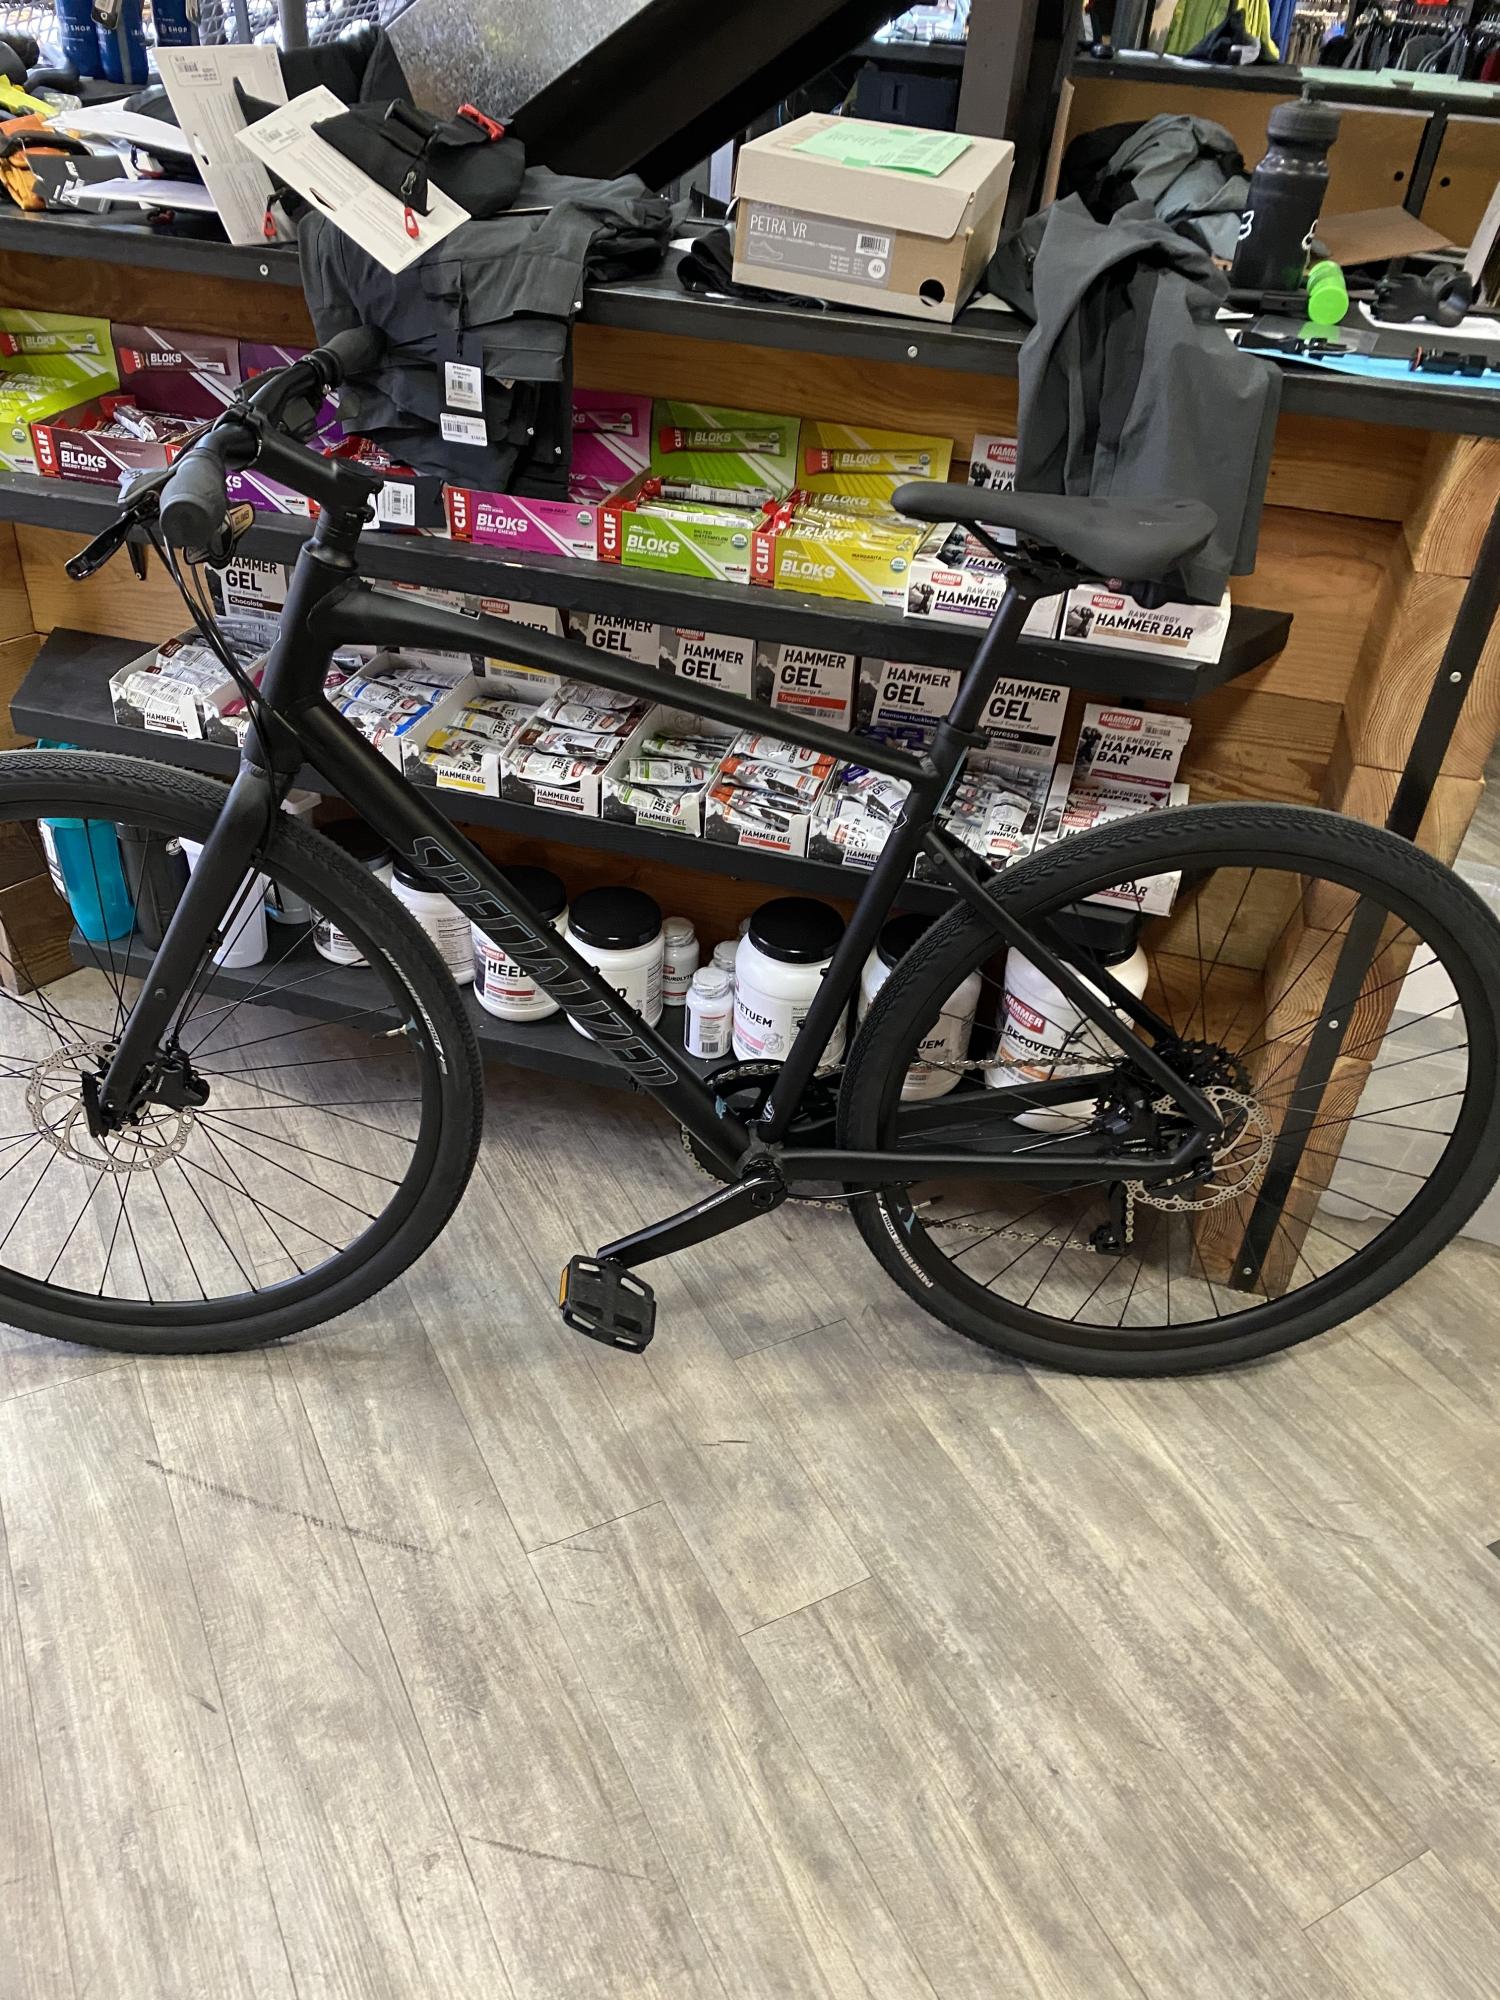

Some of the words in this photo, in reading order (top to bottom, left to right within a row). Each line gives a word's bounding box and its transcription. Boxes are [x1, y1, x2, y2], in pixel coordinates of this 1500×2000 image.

[750, 214, 787, 236] PETRA
[792, 221, 808, 239] VR
[25, 335, 56, 345] BLOKS
[150, 352, 182, 363] BLOKS
[674, 429, 682, 448] CLIF
[694, 432, 731, 443] BLOKS
[36, 429, 53, 465] CLIF
[60, 450, 107, 469] BLOKS
[61, 462, 81, 470] ENERGY
[841, 453, 881, 465] BLOKS
[822, 493, 871, 507] BLOKS
[453, 491, 466, 528] CLIF
[476, 513, 528, 532] BLOKS
[476, 526, 497, 534] ENERGY
[603, 513, 616, 550] CLIF
[627, 534, 680, 555] BLOKS
[756, 537, 770, 574] CLIF
[852, 553, 882, 561] MARGARITA
[230, 557, 278, 575] AMMER
[780, 559, 837, 579] BLOKS
[225, 569, 263, 592] GEL
[966, 585, 985, 595] RAW
[230, 596, 264, 608] Chocolate
[482, 599, 509, 611] HAMMER
[936, 590, 999, 610] HAMMER
[1092, 595, 1124, 606] HAMMER
[594, 614, 653, 633] HAMMER
[1128, 610, 1146, 619] RAW
[1148, 613, 1181, 623] ENERGY
[676, 628, 705, 638] HAMMER
[1096, 613, 1161, 635] HAMMER
[1162, 624, 1194, 640] BAR
[592, 628, 632, 653] GEL
[684, 643, 744, 665] HAMMER
[784, 648, 847, 669] HAMMER
[681, 658, 722, 682] GEL
[780, 665, 822, 688] GEL
[886, 666, 951, 688] HAMMER
[780, 693, 811, 704] Tropical
[883, 682, 926, 706] GEL
[994, 681, 1061, 703] HAMMER
[146, 712, 175, 723] HAMMER
[582, 709, 598, 722] GEL
[879, 710, 908, 721] Montana
[908, 714, 938, 724] Hucklebe
[988, 697, 1033, 723] GEL
[1101, 713, 1141, 727] HAMMER
[985, 727, 1020, 740] Espresso
[1104, 733, 1125, 741] RAW
[1126, 736, 1162, 747] ENERGY
[1096, 751, 1130, 766] BAR
[1100, 740, 1173, 761] HAMMER
[439, 769, 471, 782] HAMMER
[472, 775, 486, 784] GEL
[537, 788, 570, 801] HAMMER
[570, 796, 585, 804] GEL
[872, 783, 889, 795] GEL
[1120, 790, 1147, 799] ENERGY
[638, 810, 671, 823] HAMMER
[672, 818, 687, 826] GEL
[1063, 815, 1091, 825] HAMMER
[742, 829, 776, 841] HAMMER
[776, 835, 792, 844] GEL
[998, 823, 1020, 834] GEL
[1120, 880, 1148, 896] BAR
[408, 836, 679, 1086] SPECIALIZED
[1005, 993, 1044, 1028] HAMMER
[882, 1213, 897, 1236] SPORT
